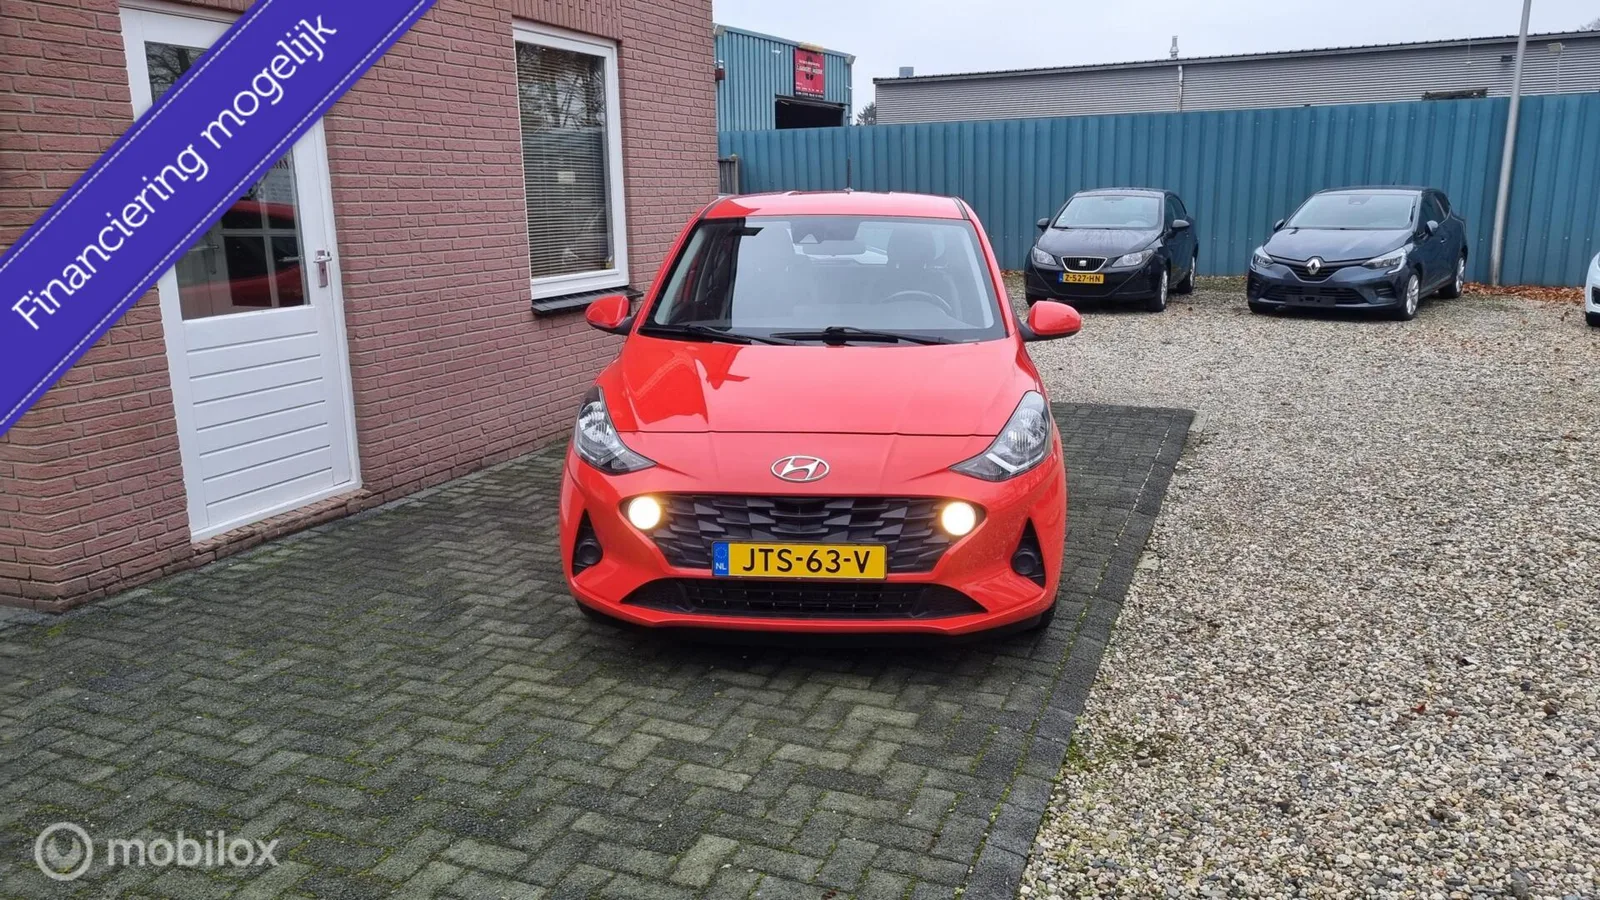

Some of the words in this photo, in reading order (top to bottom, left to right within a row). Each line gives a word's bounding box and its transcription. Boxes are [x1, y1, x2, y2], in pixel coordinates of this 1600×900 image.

[1065, 274, 1101, 282] Z-527-HN
[743, 548, 870, 573] JTS-63-V
[715, 562, 727, 570] NL
